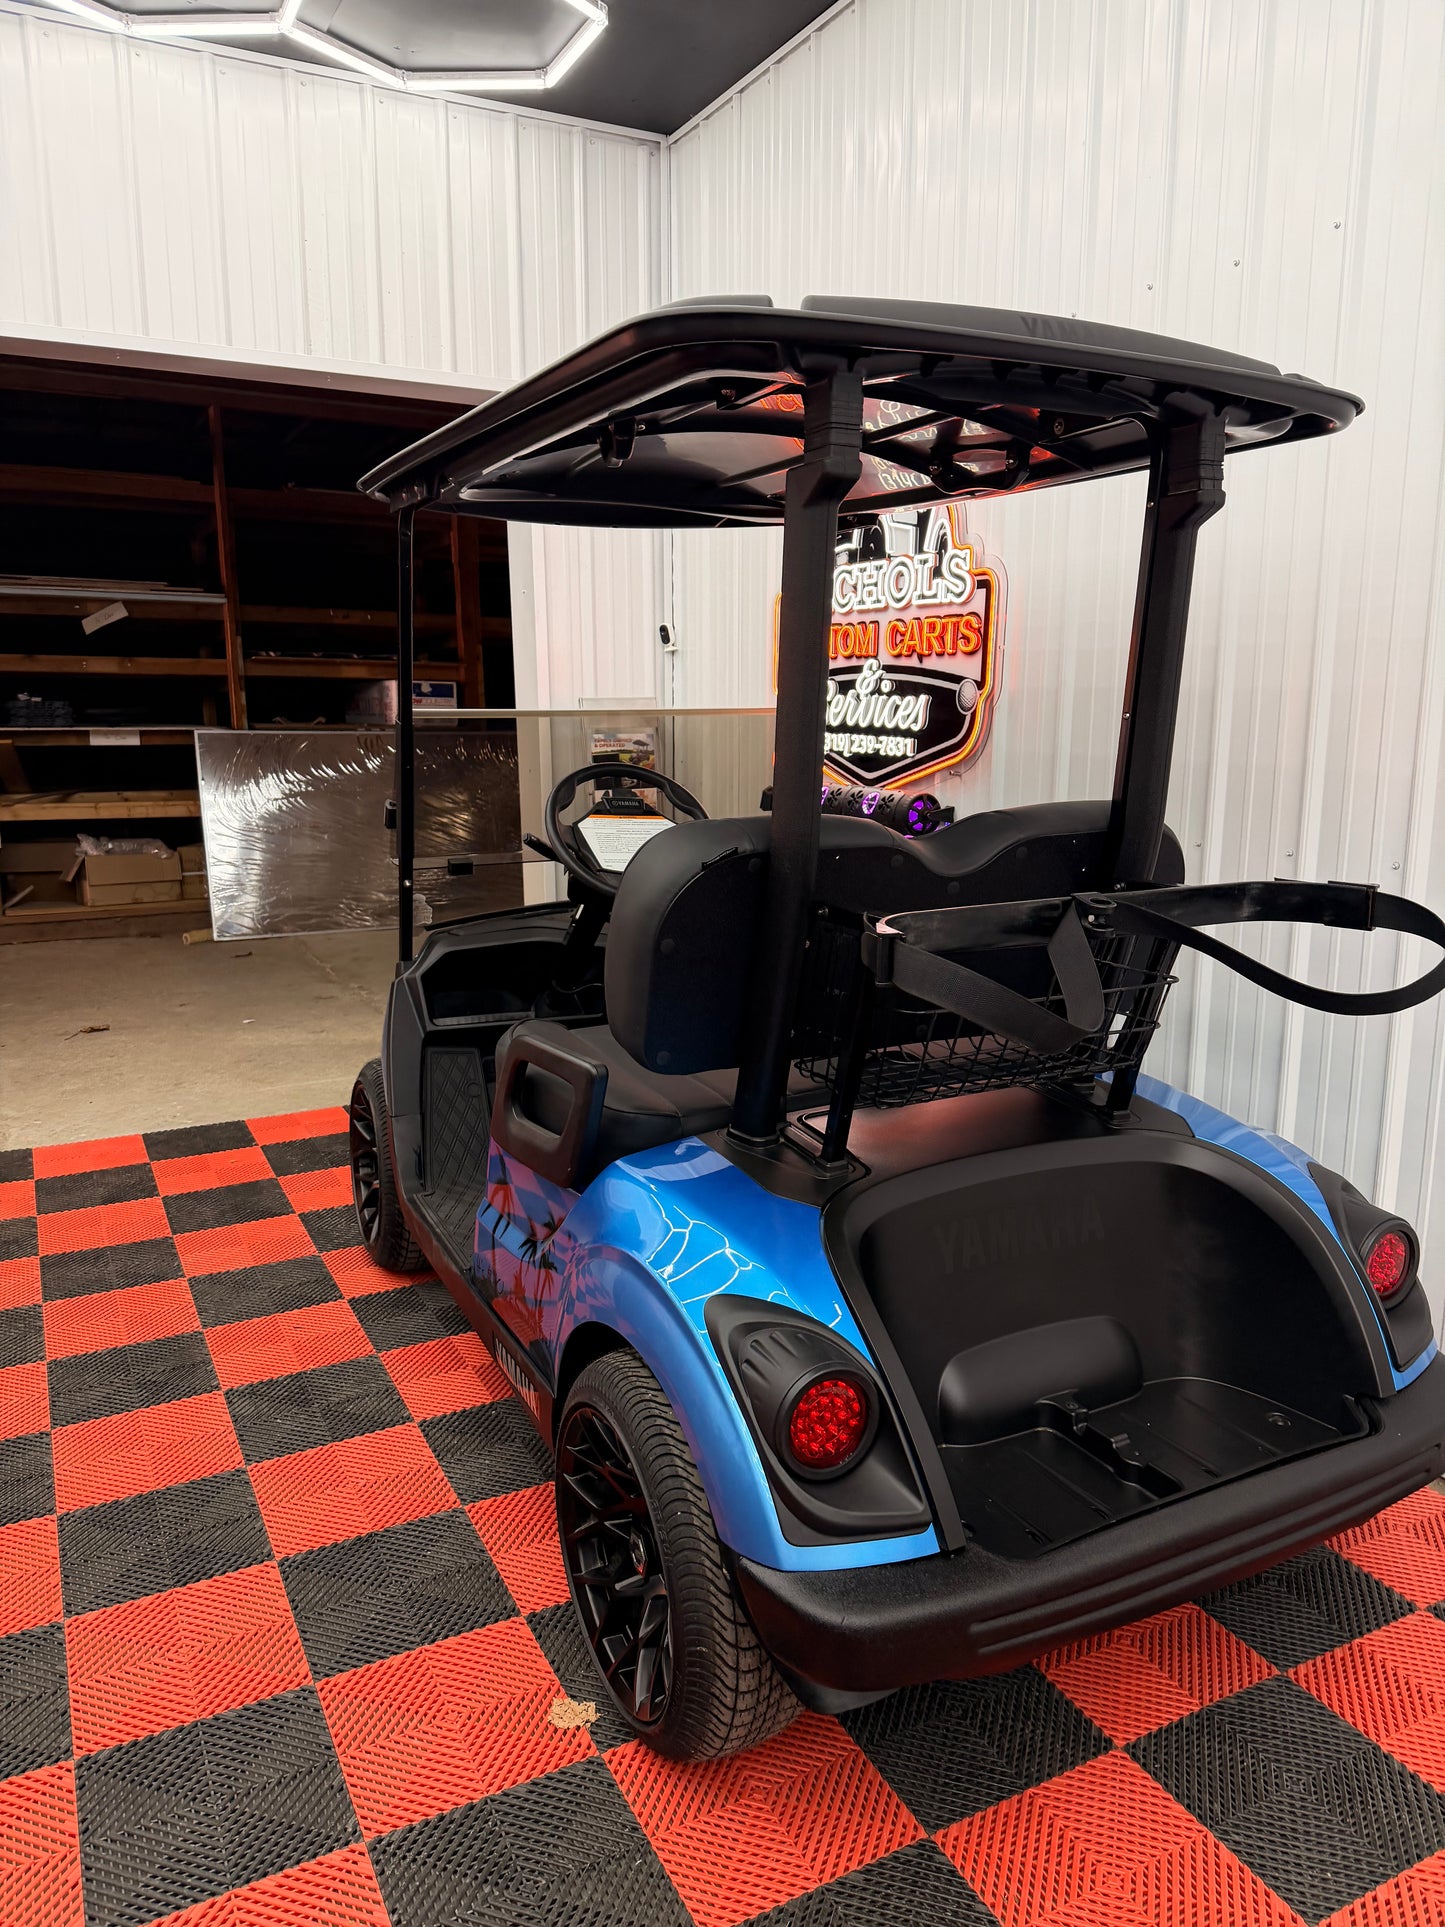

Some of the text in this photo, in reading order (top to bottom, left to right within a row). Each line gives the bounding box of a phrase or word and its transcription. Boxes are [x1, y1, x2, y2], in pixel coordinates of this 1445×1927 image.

[832, 549, 974, 613] CHOLS
[829, 612, 983, 659] TOM CARTS
[855, 658, 885, 697] &
[932, 1192, 1105, 1274] YAMAHA
